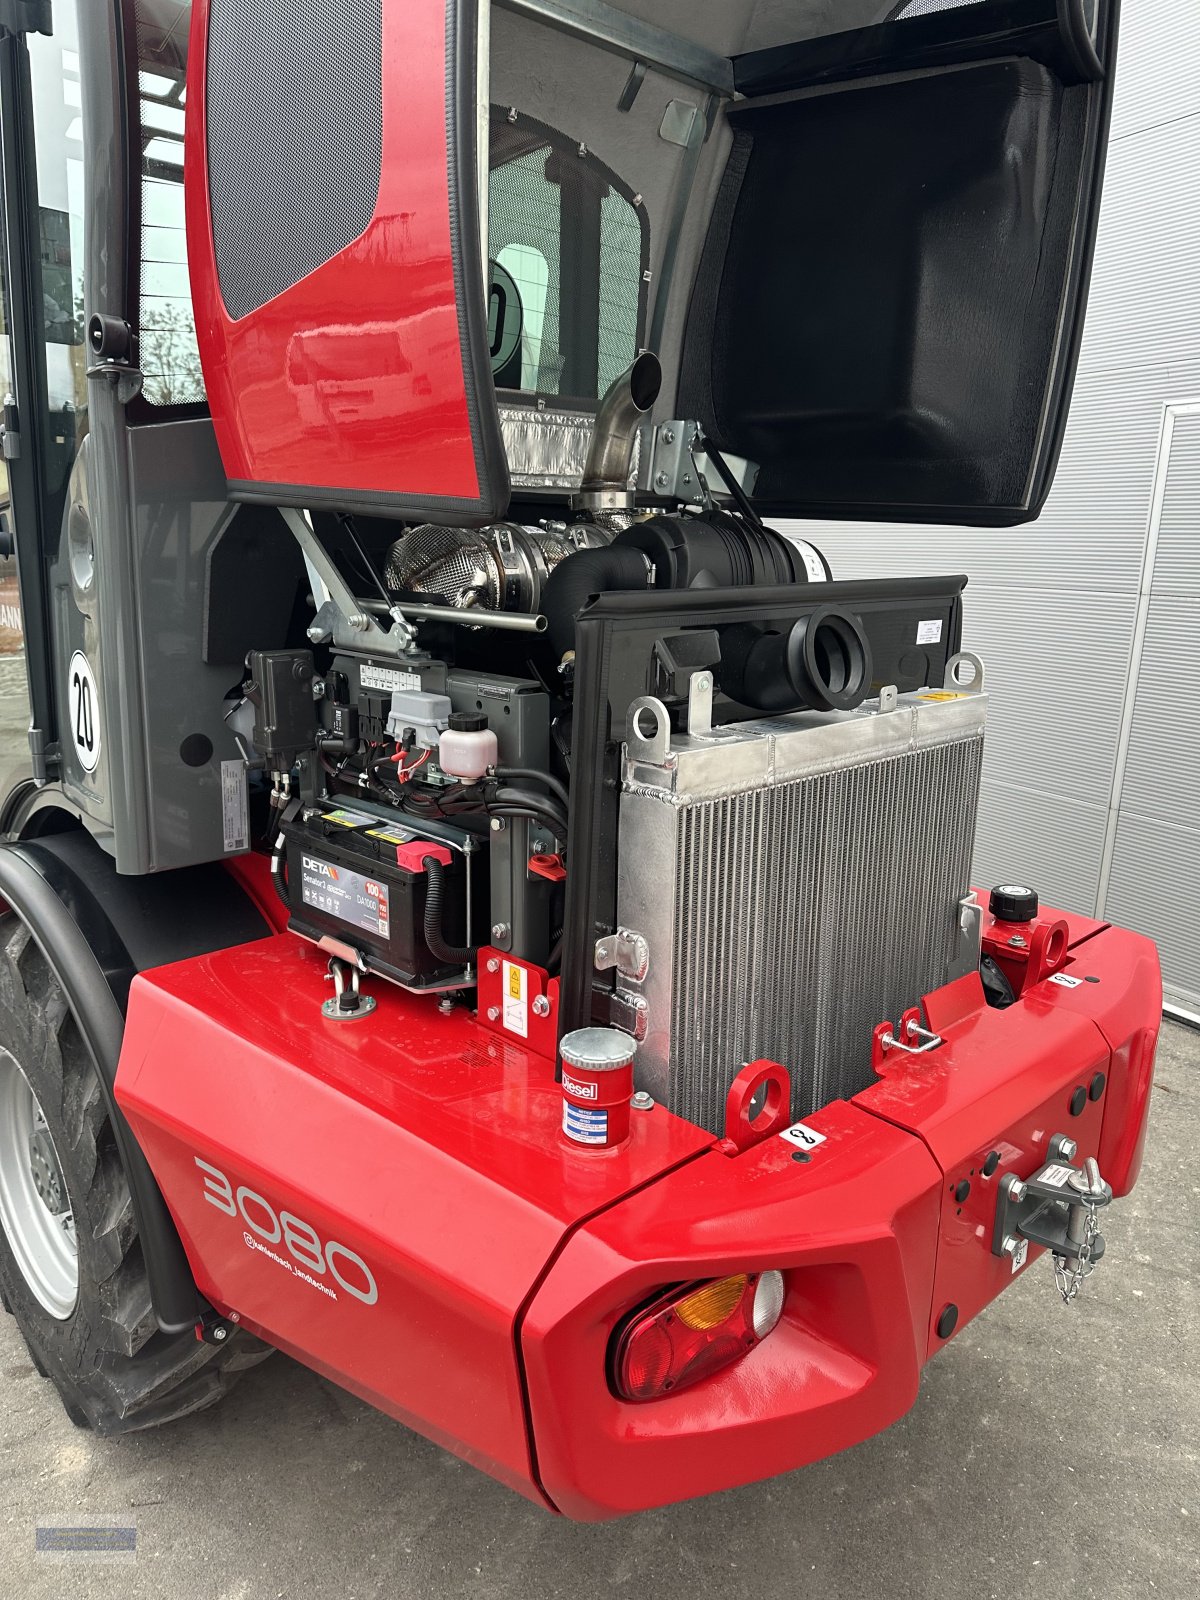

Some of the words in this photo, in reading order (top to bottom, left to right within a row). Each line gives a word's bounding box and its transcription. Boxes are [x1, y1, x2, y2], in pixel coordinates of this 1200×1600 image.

[73, 671, 94, 752] 20
[302, 856, 331, 878] DETA
[366, 882, 379, 897] 100
[562, 1072, 595, 1098] Diesel
[193, 1155, 378, 1305] 3080
